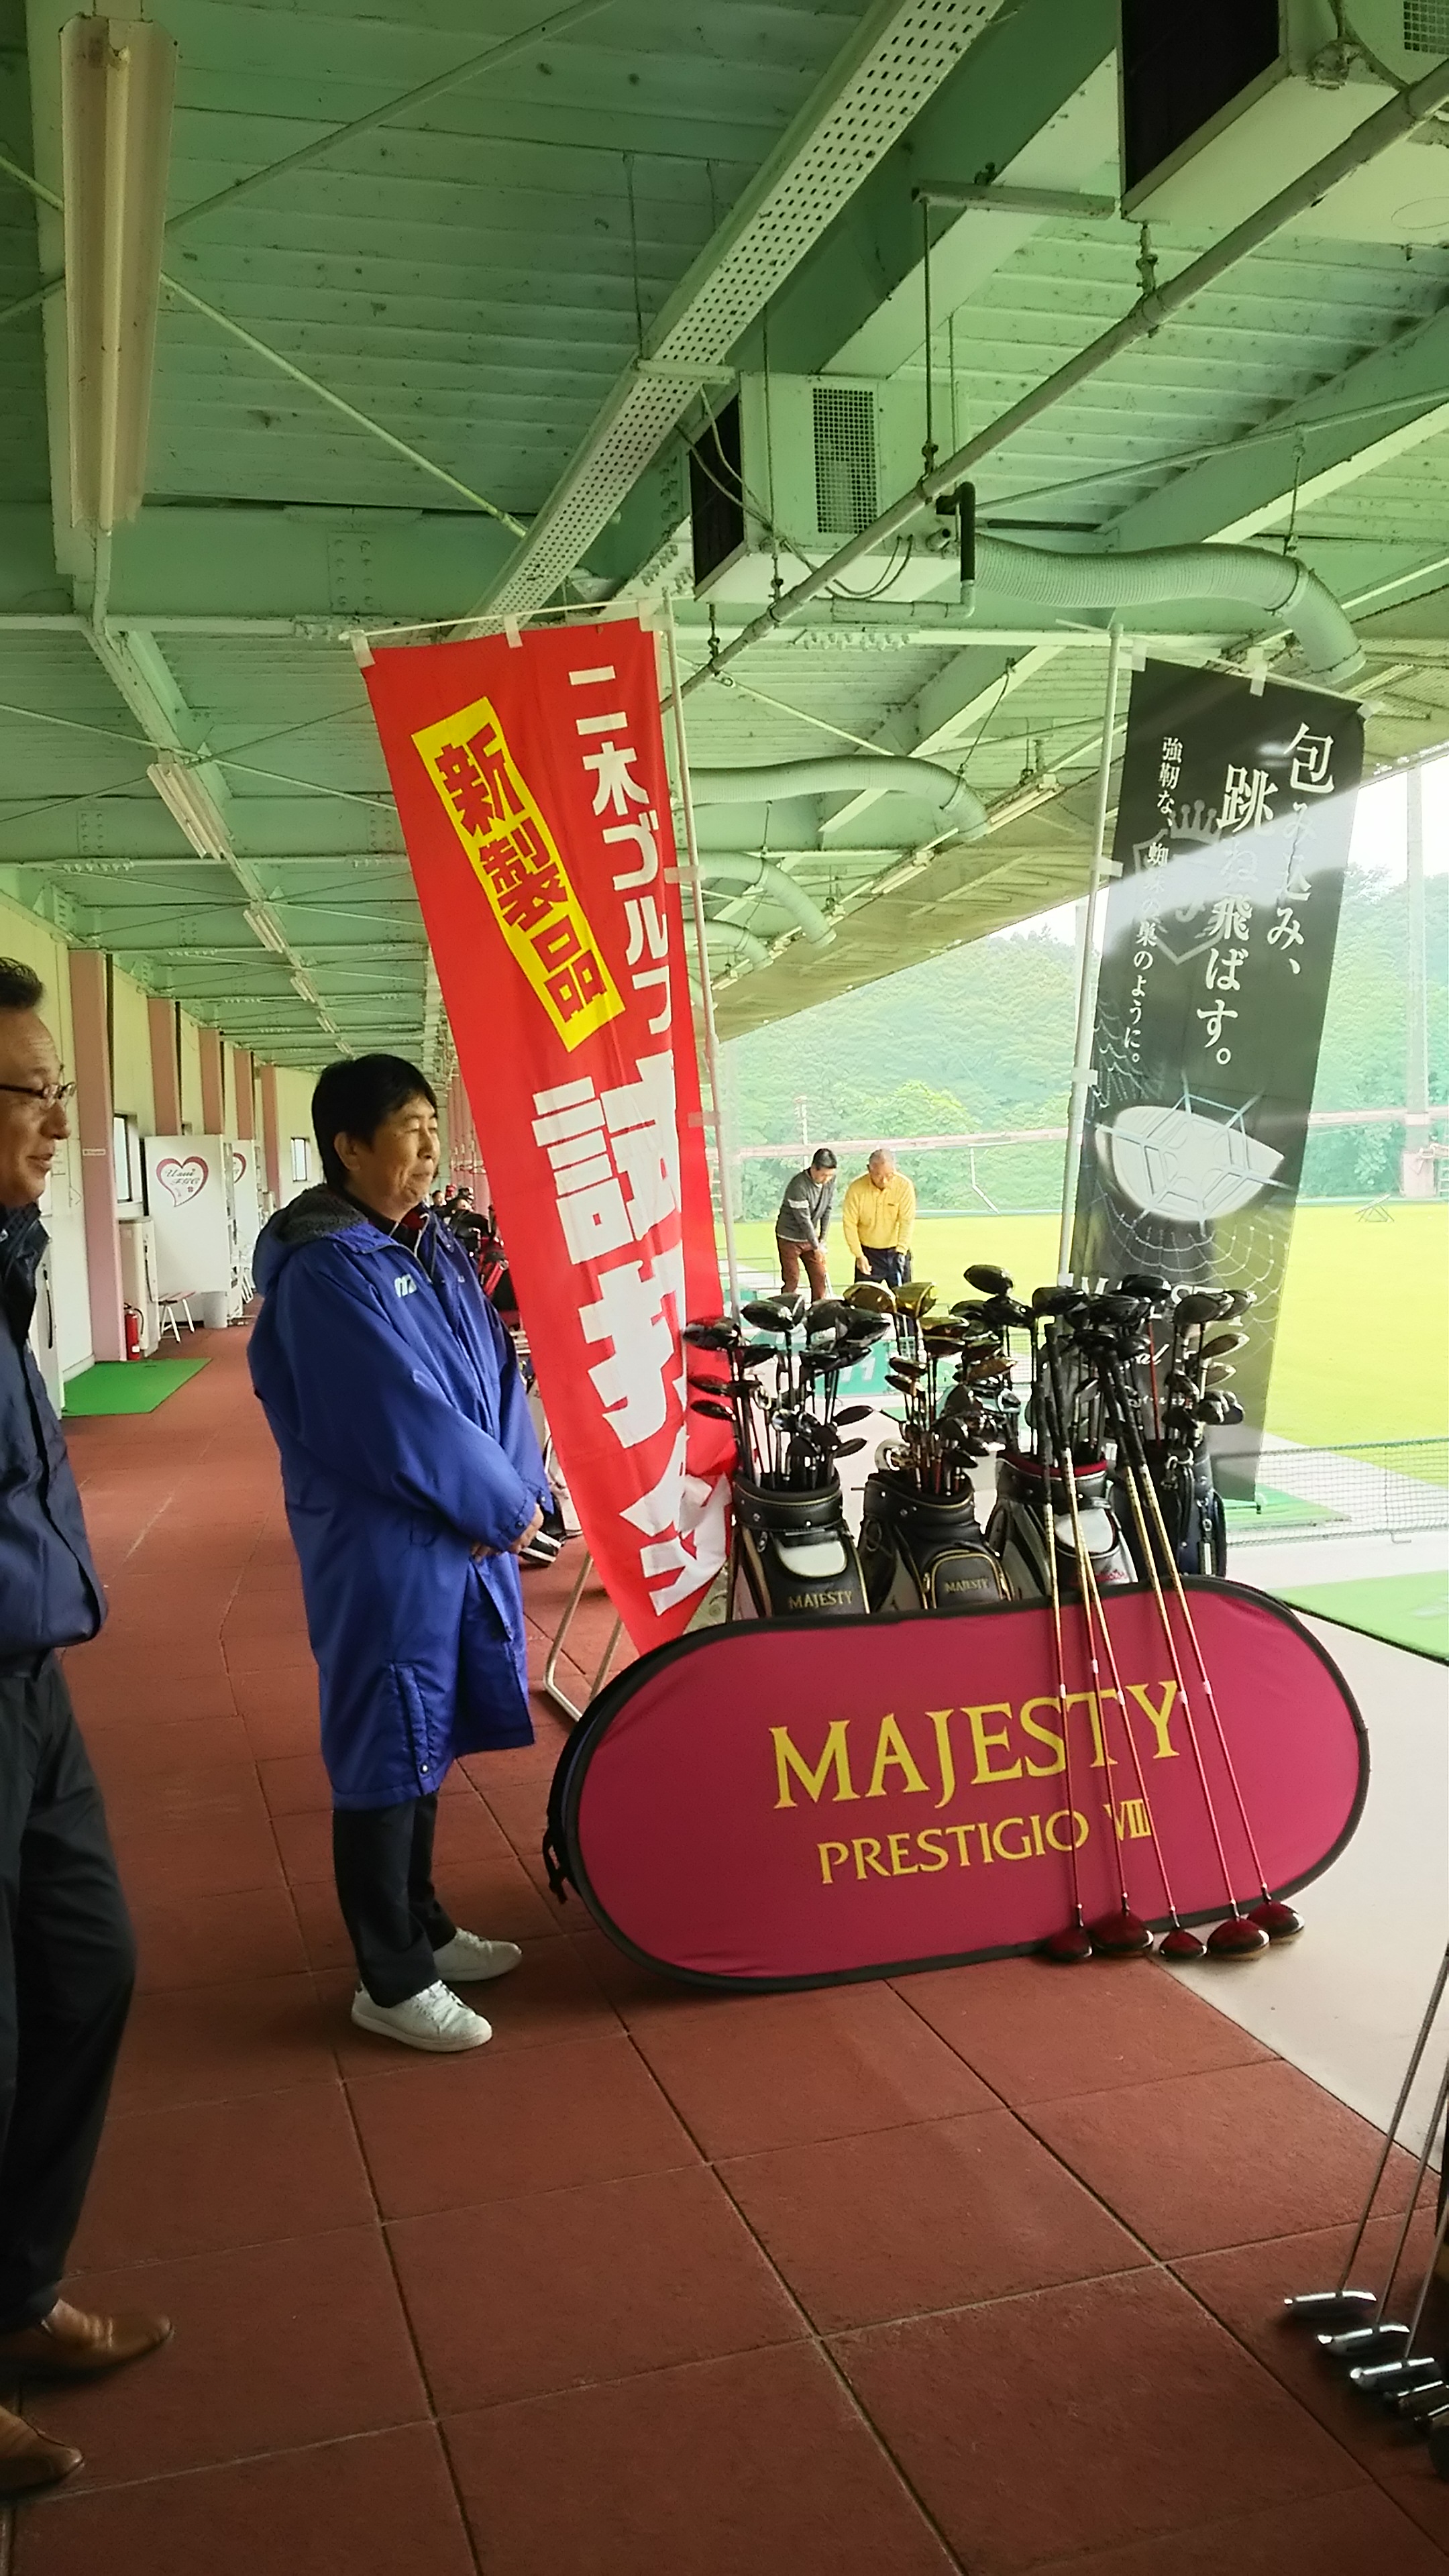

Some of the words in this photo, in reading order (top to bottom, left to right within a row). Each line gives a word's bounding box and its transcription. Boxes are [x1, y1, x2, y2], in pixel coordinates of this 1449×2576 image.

[434, 722, 607, 1023] 新製品
[789, 1591, 853, 1609] MAJESTY
[943, 1577, 990, 1593] MAJESTY
[769, 1680, 1179, 1809] MAJESTY
[816, 1809, 1089, 1884] PRESTIGIO
